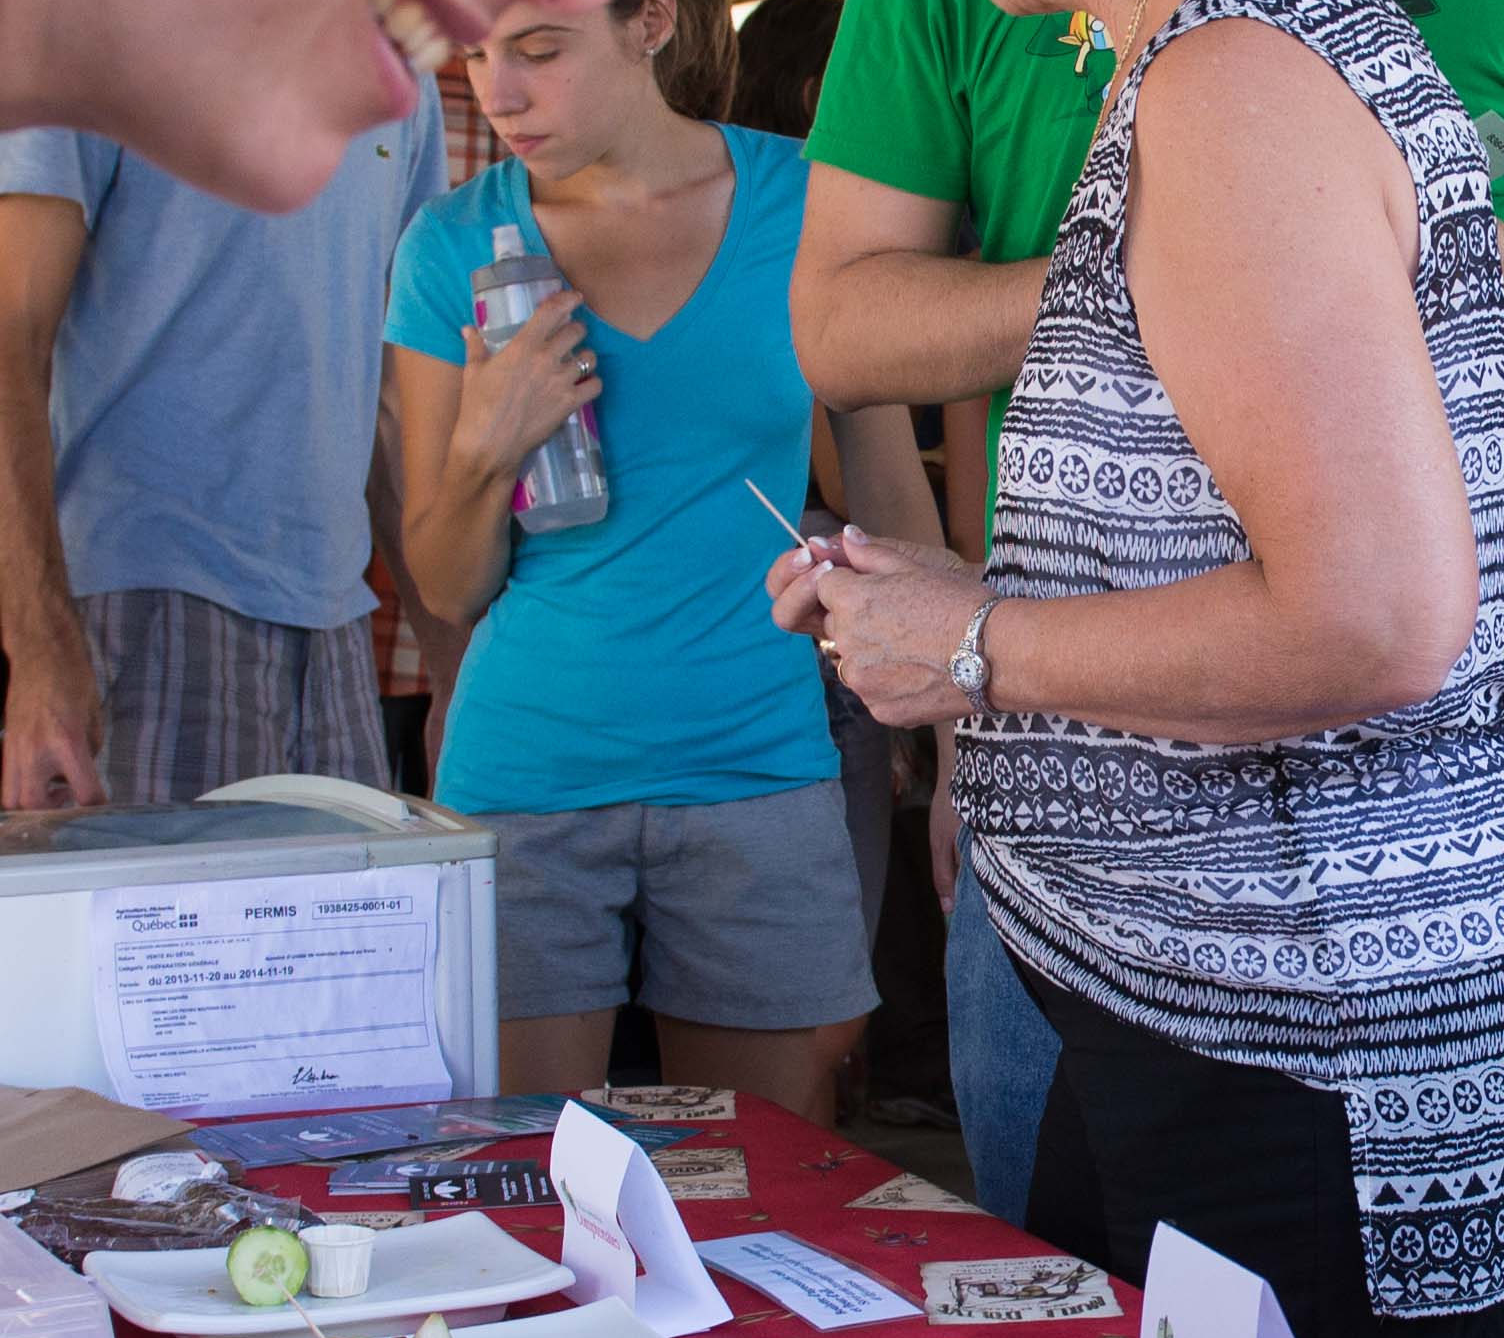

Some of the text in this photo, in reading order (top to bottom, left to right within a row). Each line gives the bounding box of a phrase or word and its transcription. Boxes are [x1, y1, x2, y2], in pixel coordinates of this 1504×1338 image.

[244, 905, 297, 920] PERMIS
[318, 900, 402, 914] 1938425-0001-01
[131, 918, 177, 933] Québec
[148, 975, 162, 986] du
[164, 971, 221, 985] 2013-11-20
[223, 972, 236, 980] au
[238, 965, 294, 980] 2014-11-19
